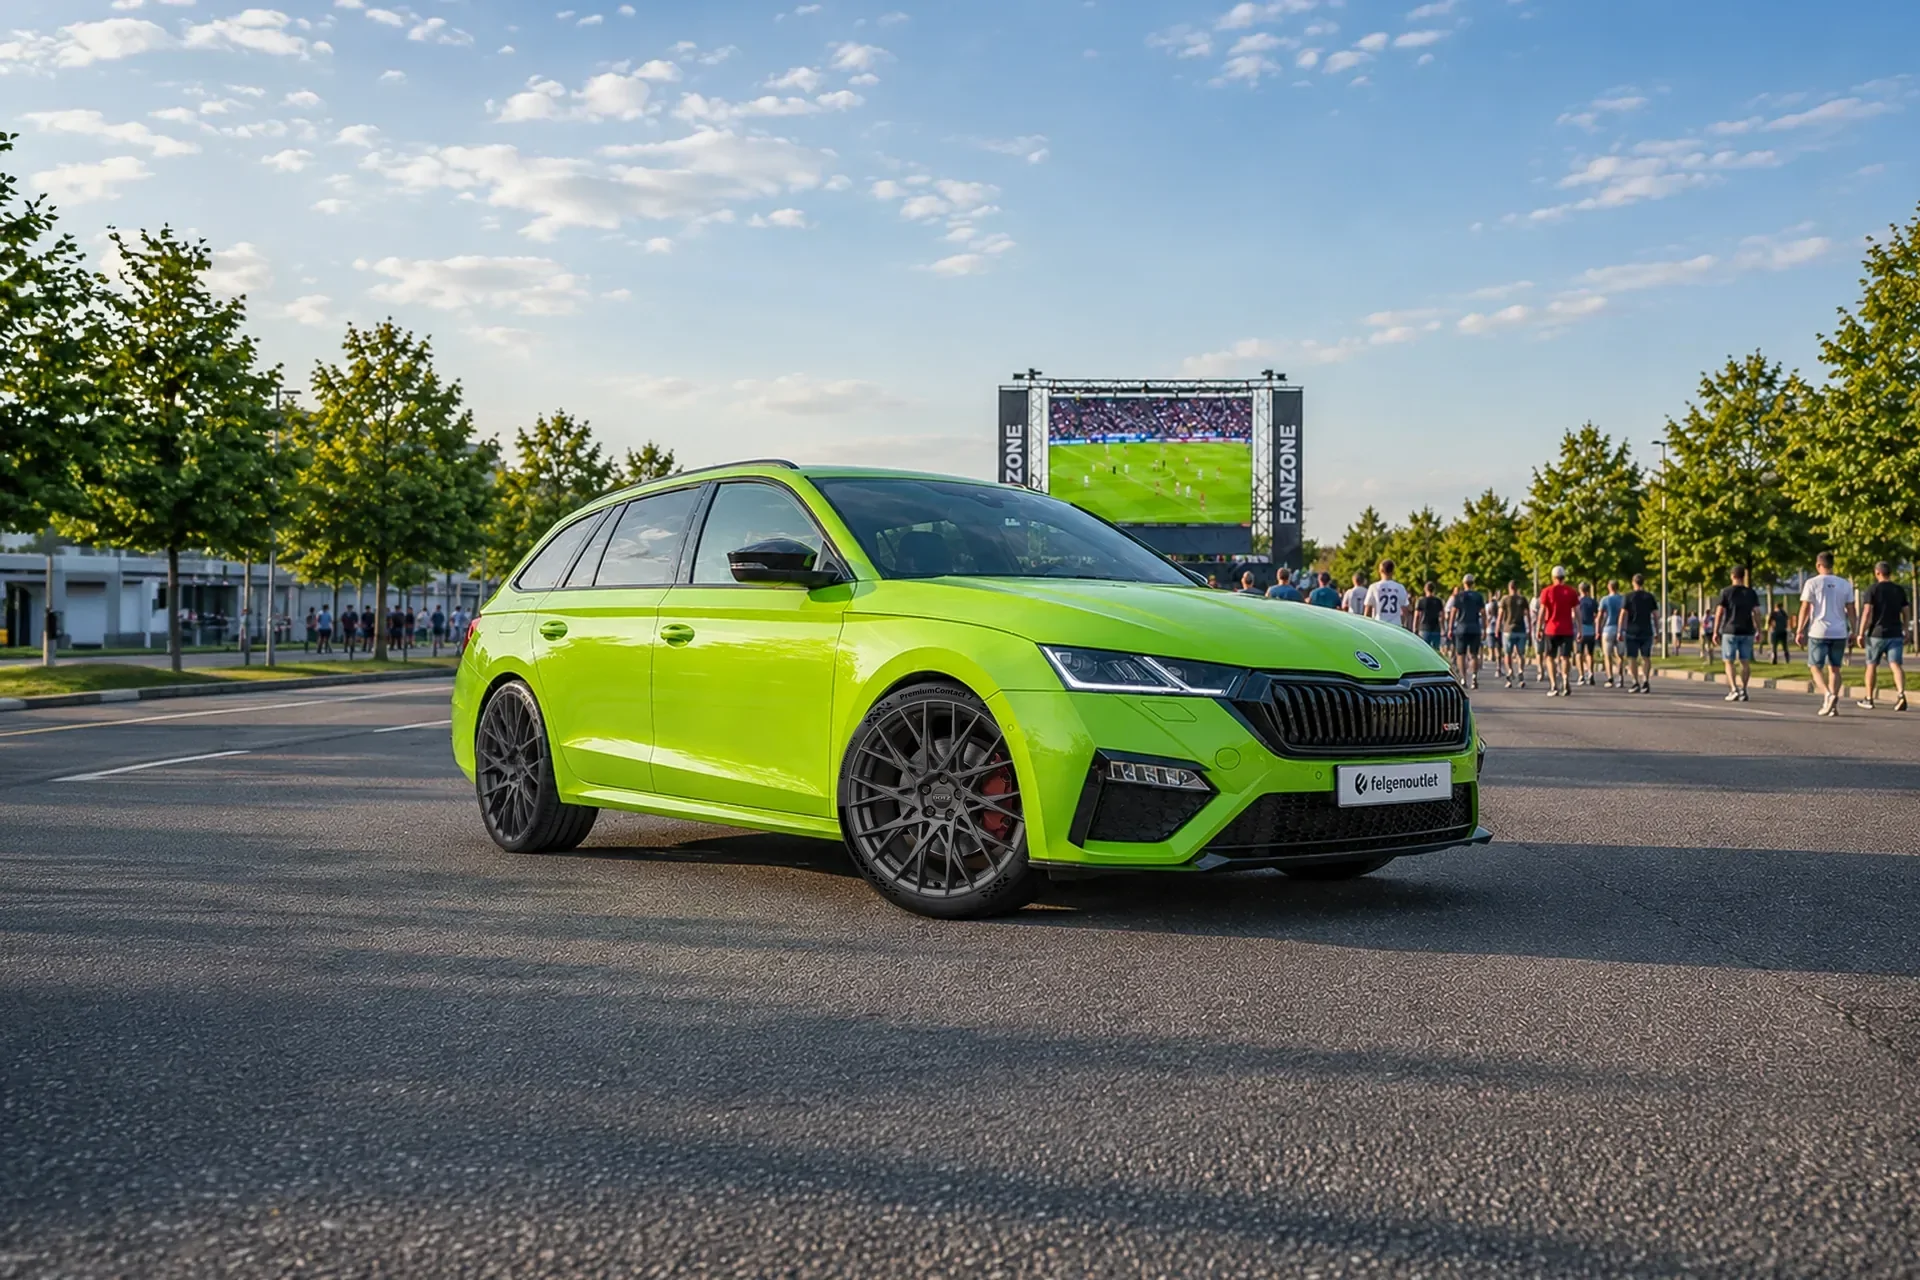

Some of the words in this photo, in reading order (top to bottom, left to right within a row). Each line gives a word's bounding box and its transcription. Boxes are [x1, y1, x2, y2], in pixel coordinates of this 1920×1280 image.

[1006, 425, 1022, 483] ZONE
[1280, 425, 1296, 524] FANZONE
[1379, 594, 1398, 614] 23
[899, 687, 966, 700] PremiumContact
[1371, 773, 1439, 793] felgenoutlet
